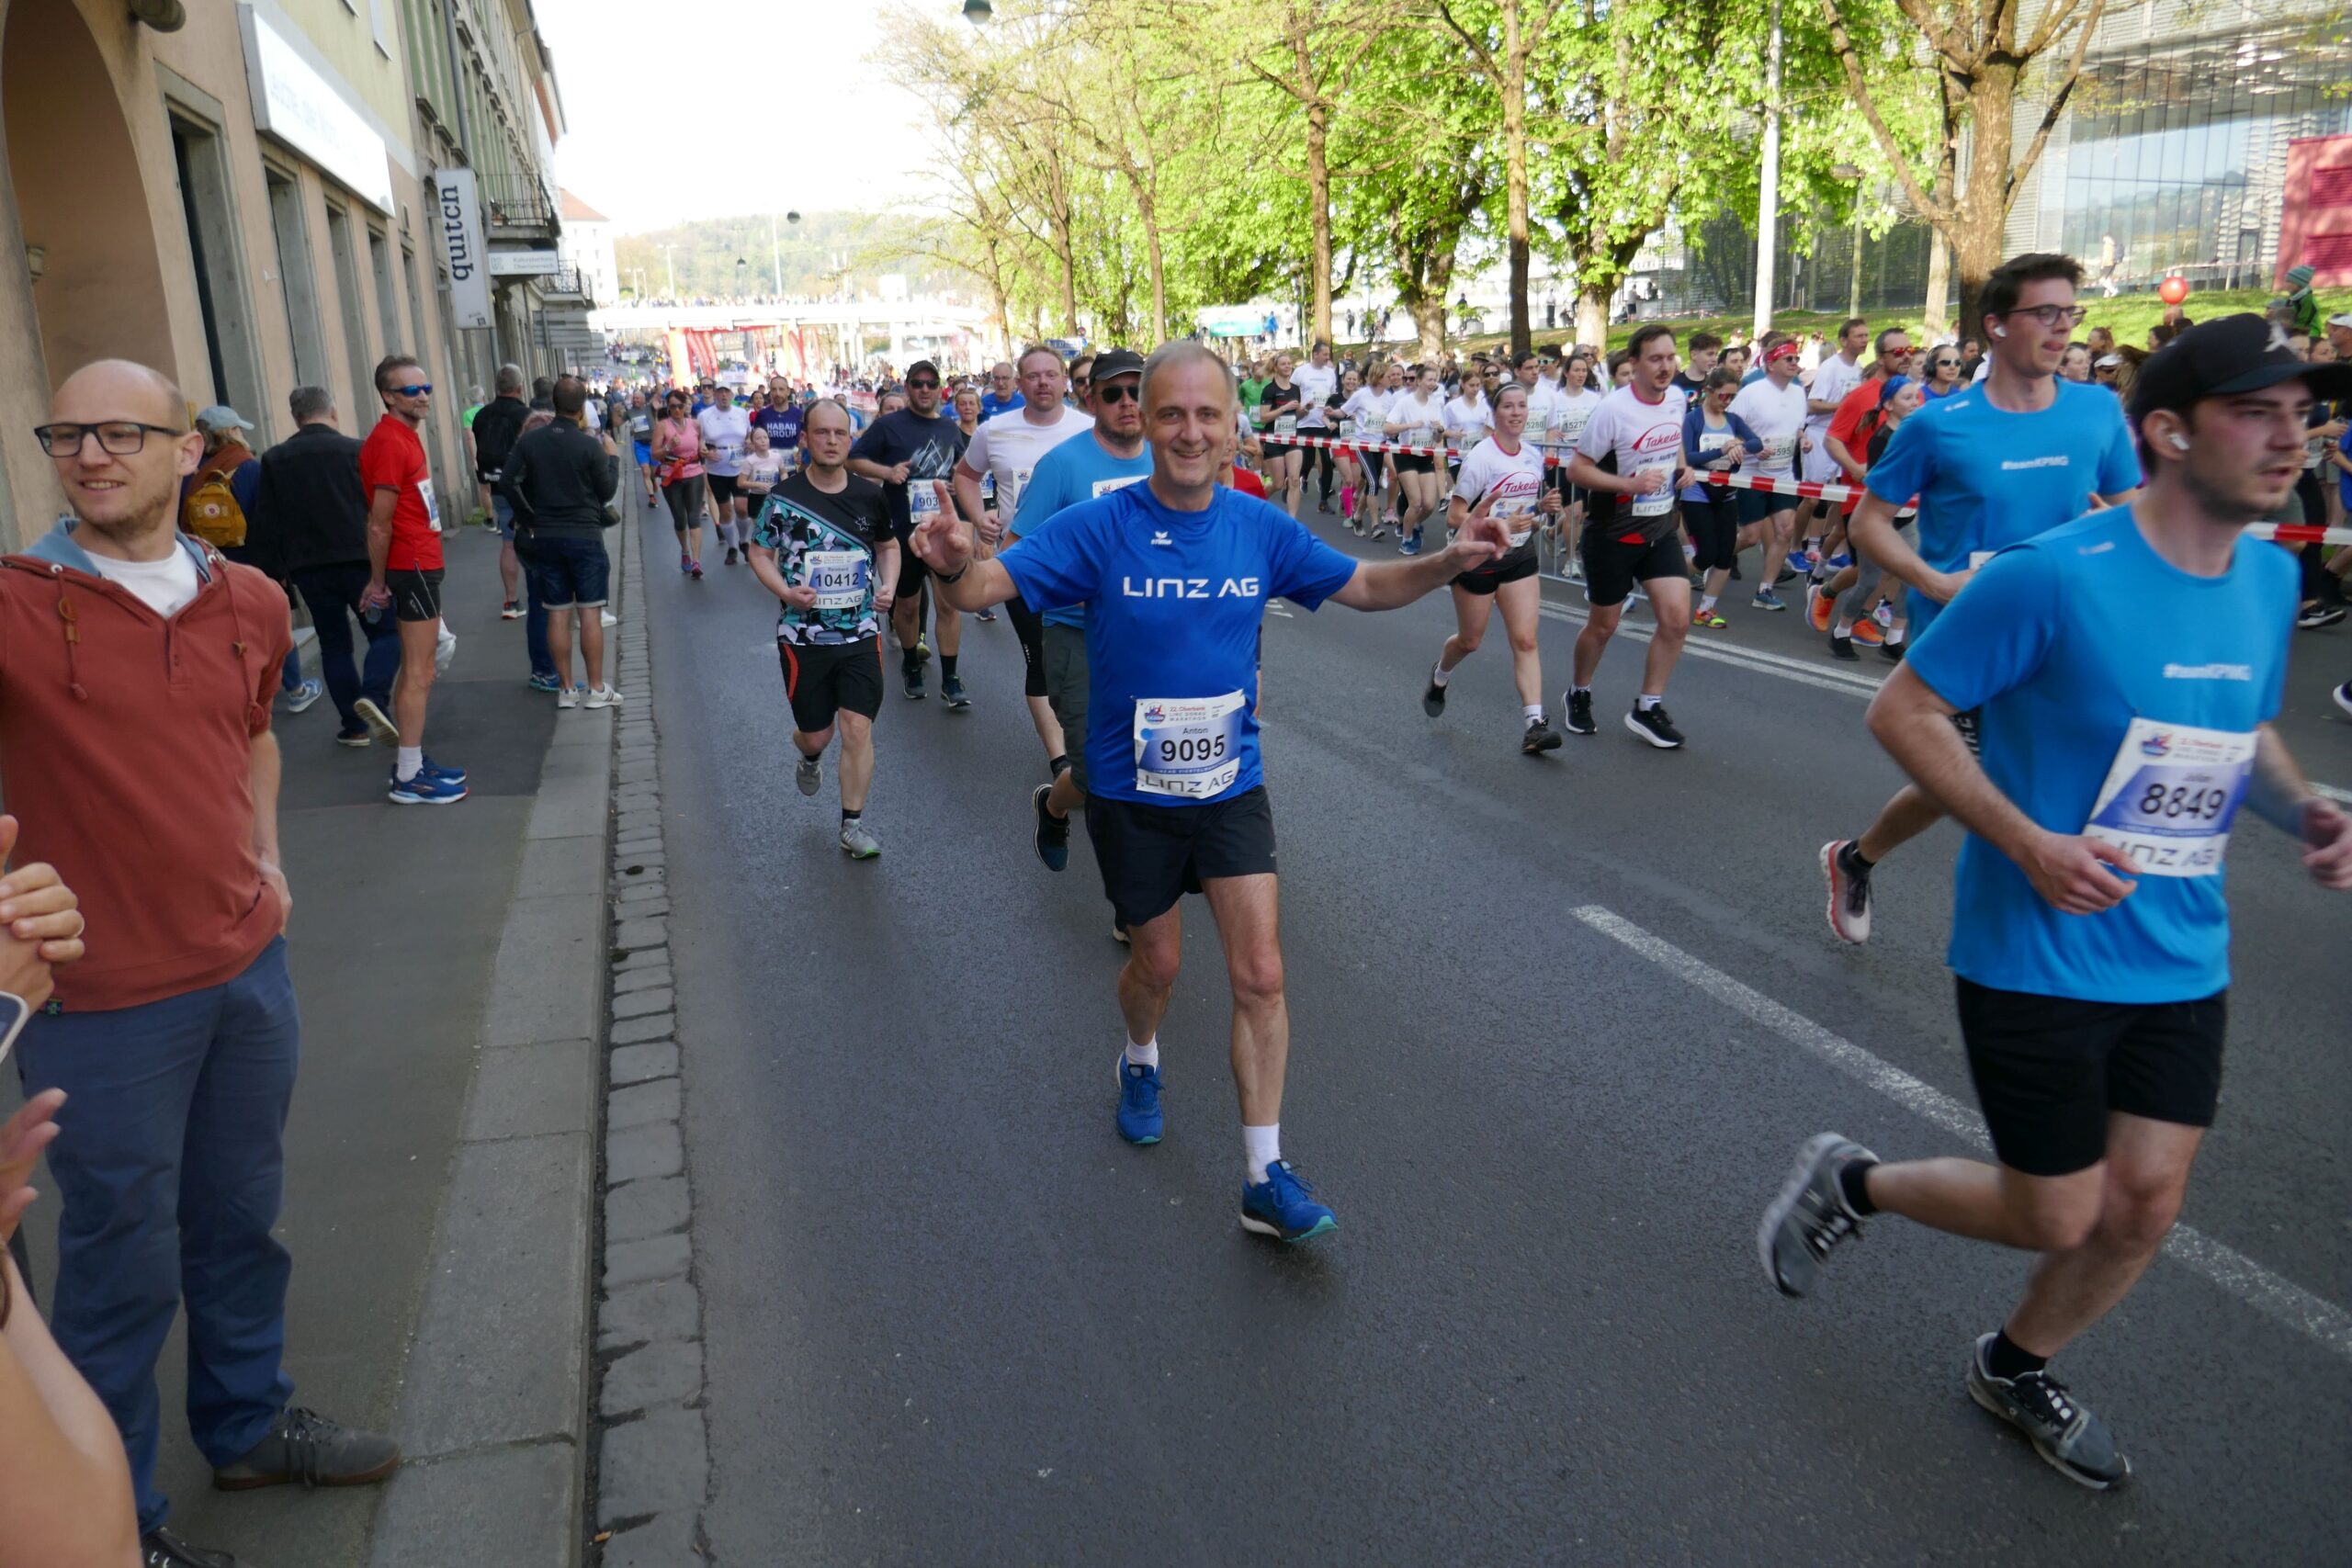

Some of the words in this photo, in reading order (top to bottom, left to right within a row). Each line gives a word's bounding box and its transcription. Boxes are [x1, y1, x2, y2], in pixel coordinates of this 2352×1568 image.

[440, 185, 474, 282] quitch
[766, 423, 797, 431] HABAU
[1526, 421, 1544, 429] 5280
[768, 430, 797, 438] GROUP
[919, 496, 939, 508] 903
[815, 572, 860, 587] 10412
[1123, 576, 1210, 598] LINZ
[1216, 577, 1260, 598] AG
[814, 597, 842, 605] INZ
[845, 595, 862, 604] AG
[1182, 727, 1209, 735] Anton
[1160, 734, 1226, 762] 9095
[1145, 774, 1203, 793] LINZ
[1207, 770, 1234, 791] AG
[2140, 783, 2226, 820] 8849
[2120, 840, 2179, 866] INZ
